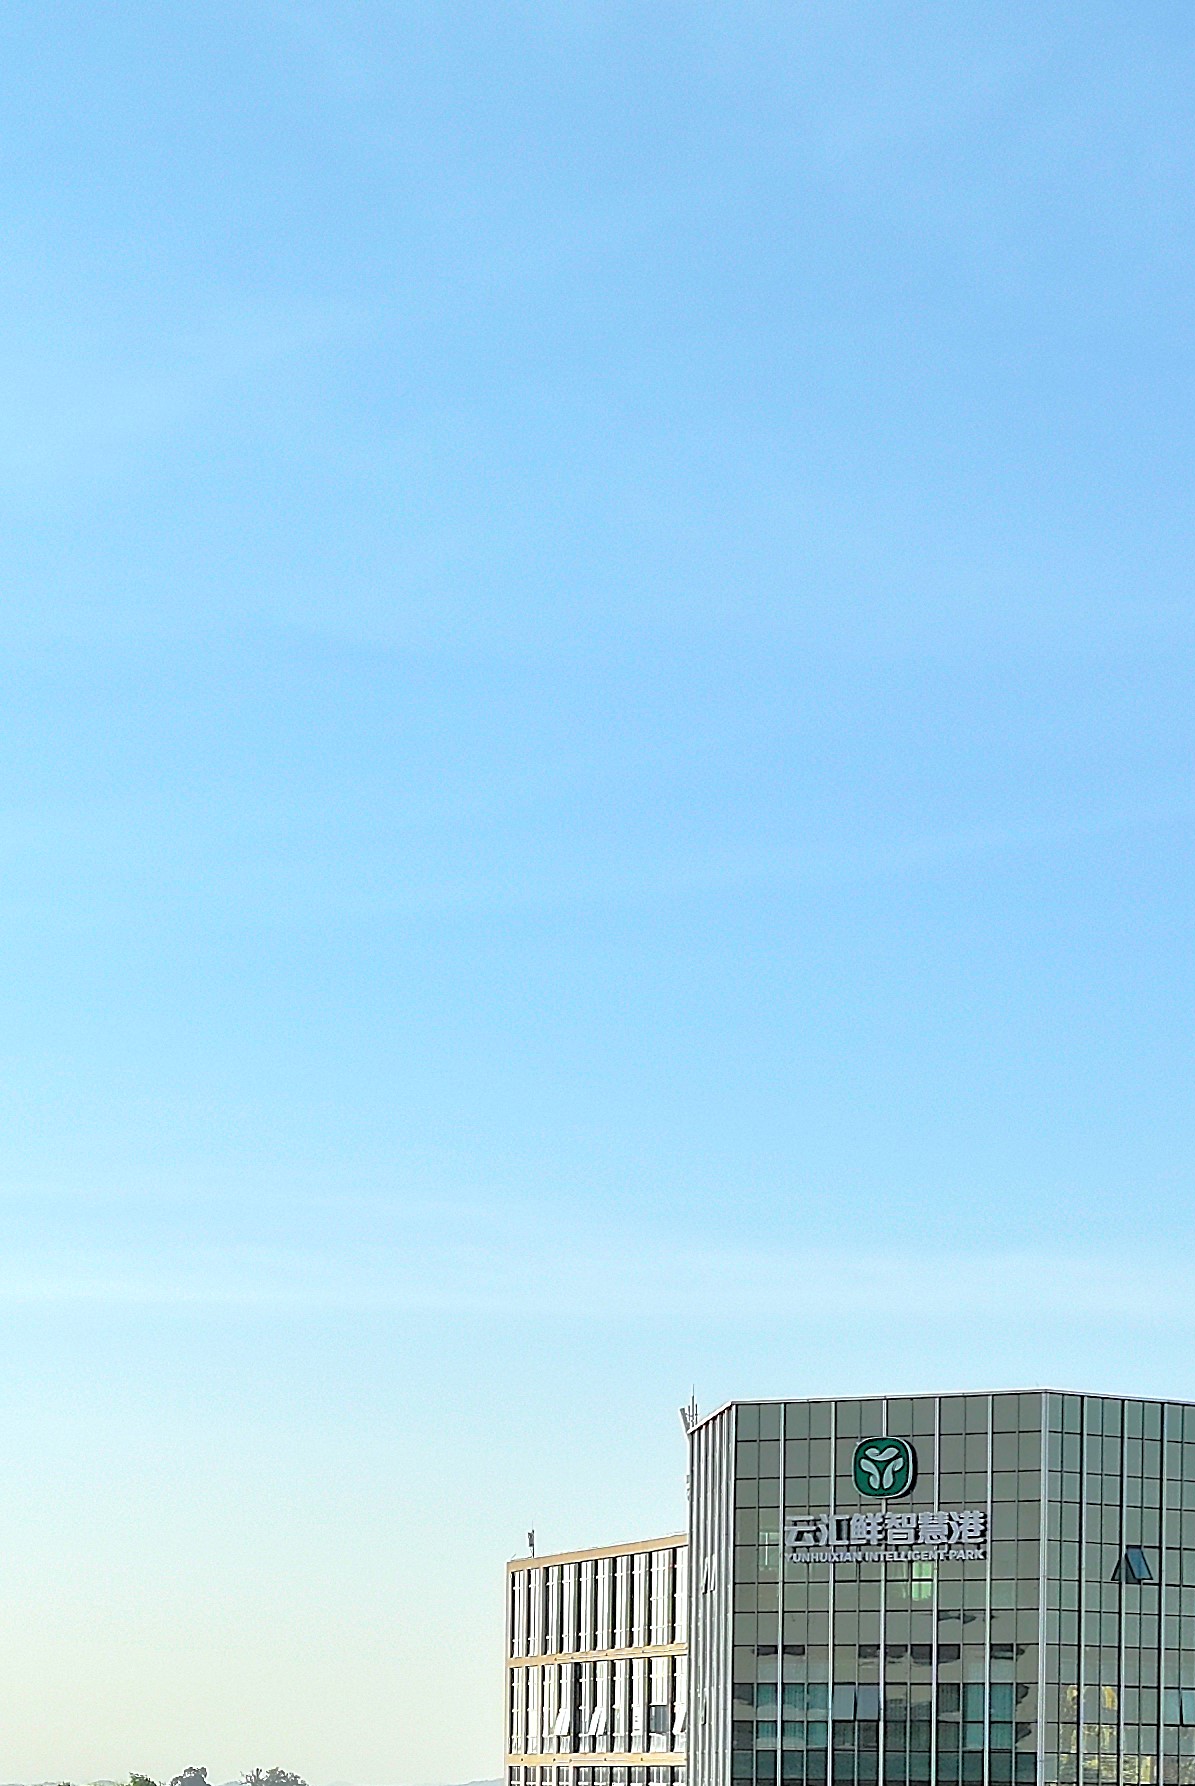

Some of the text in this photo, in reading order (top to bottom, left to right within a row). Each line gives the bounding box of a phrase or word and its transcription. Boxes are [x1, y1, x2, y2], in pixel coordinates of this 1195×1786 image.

[784, 1510, 988, 1547] 云汇鲜智慧港
[785, 1549, 985, 1562] YUNHUIXIAN INTELLIGENT PARK
